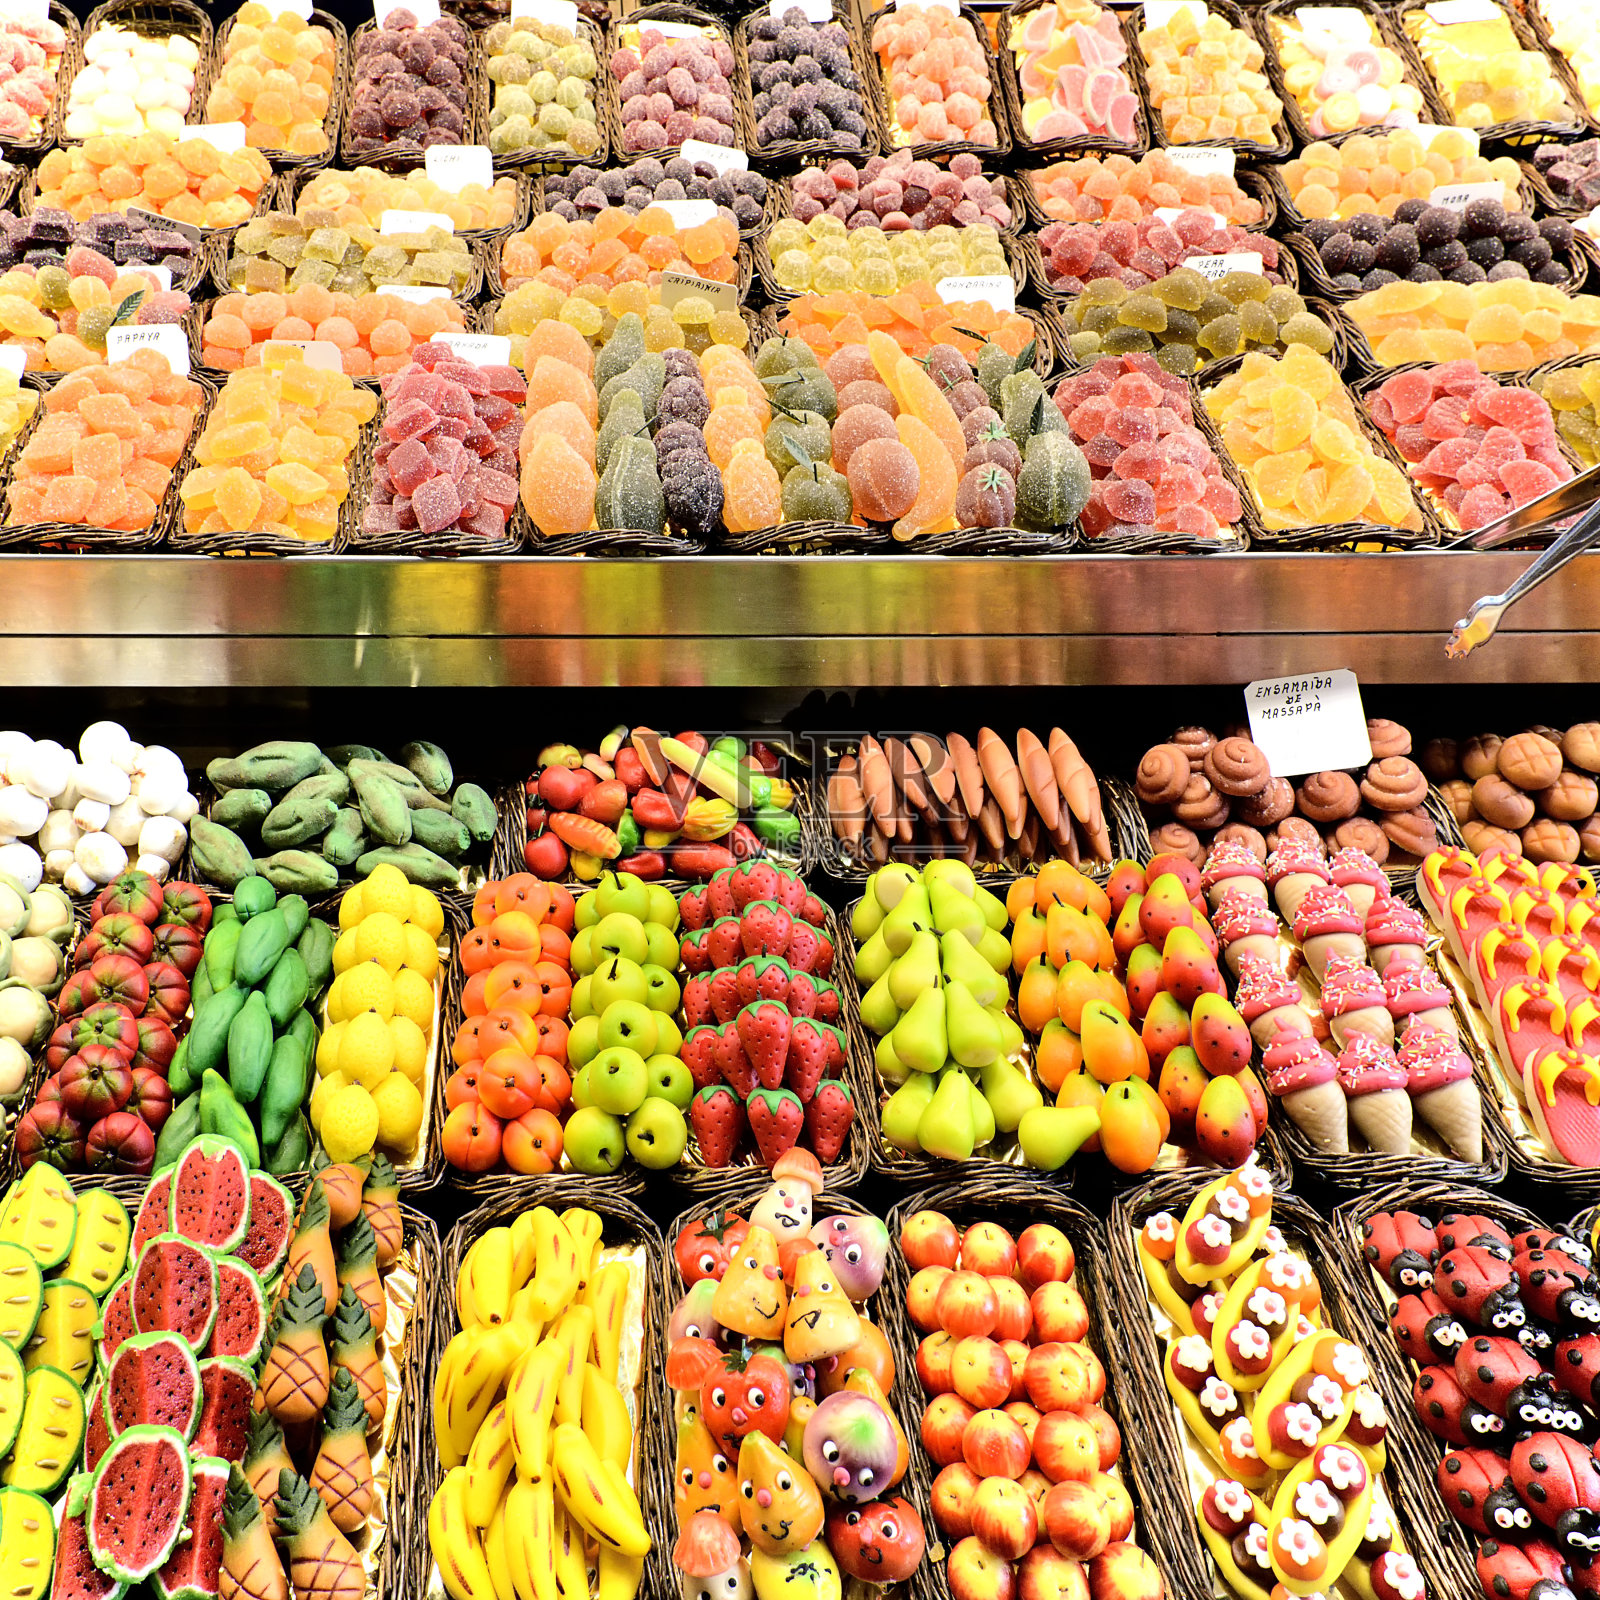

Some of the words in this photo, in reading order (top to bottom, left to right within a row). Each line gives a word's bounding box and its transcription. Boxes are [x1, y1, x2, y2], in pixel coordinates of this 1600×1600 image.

[1441, 194, 1470, 205] MORA
[116, 331, 160, 344] PAPAYA
[1285, 694, 1302, 705] DE
